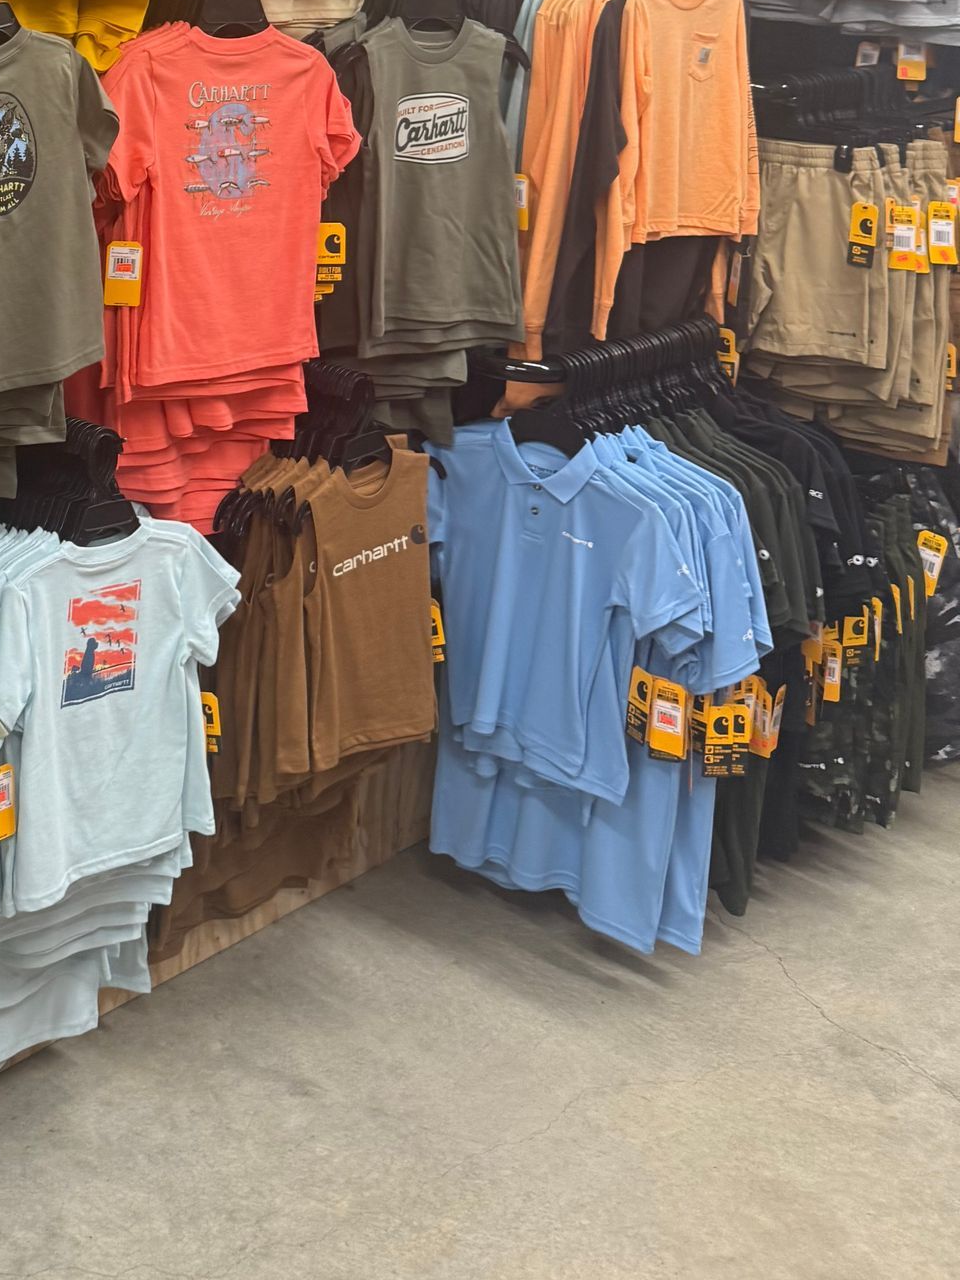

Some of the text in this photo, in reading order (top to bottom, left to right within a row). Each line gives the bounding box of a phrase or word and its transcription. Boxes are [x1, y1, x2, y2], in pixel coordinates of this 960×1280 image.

[189, 81, 272, 108] CARHARTT
[396, 105, 434, 117] BUILT FOR
[396, 107, 467, 152] Carhartt
[421, 140, 464, 156] GENERATIONS
[7, 198, 19, 210] ALL
[332, 535, 408, 577] carhartt
